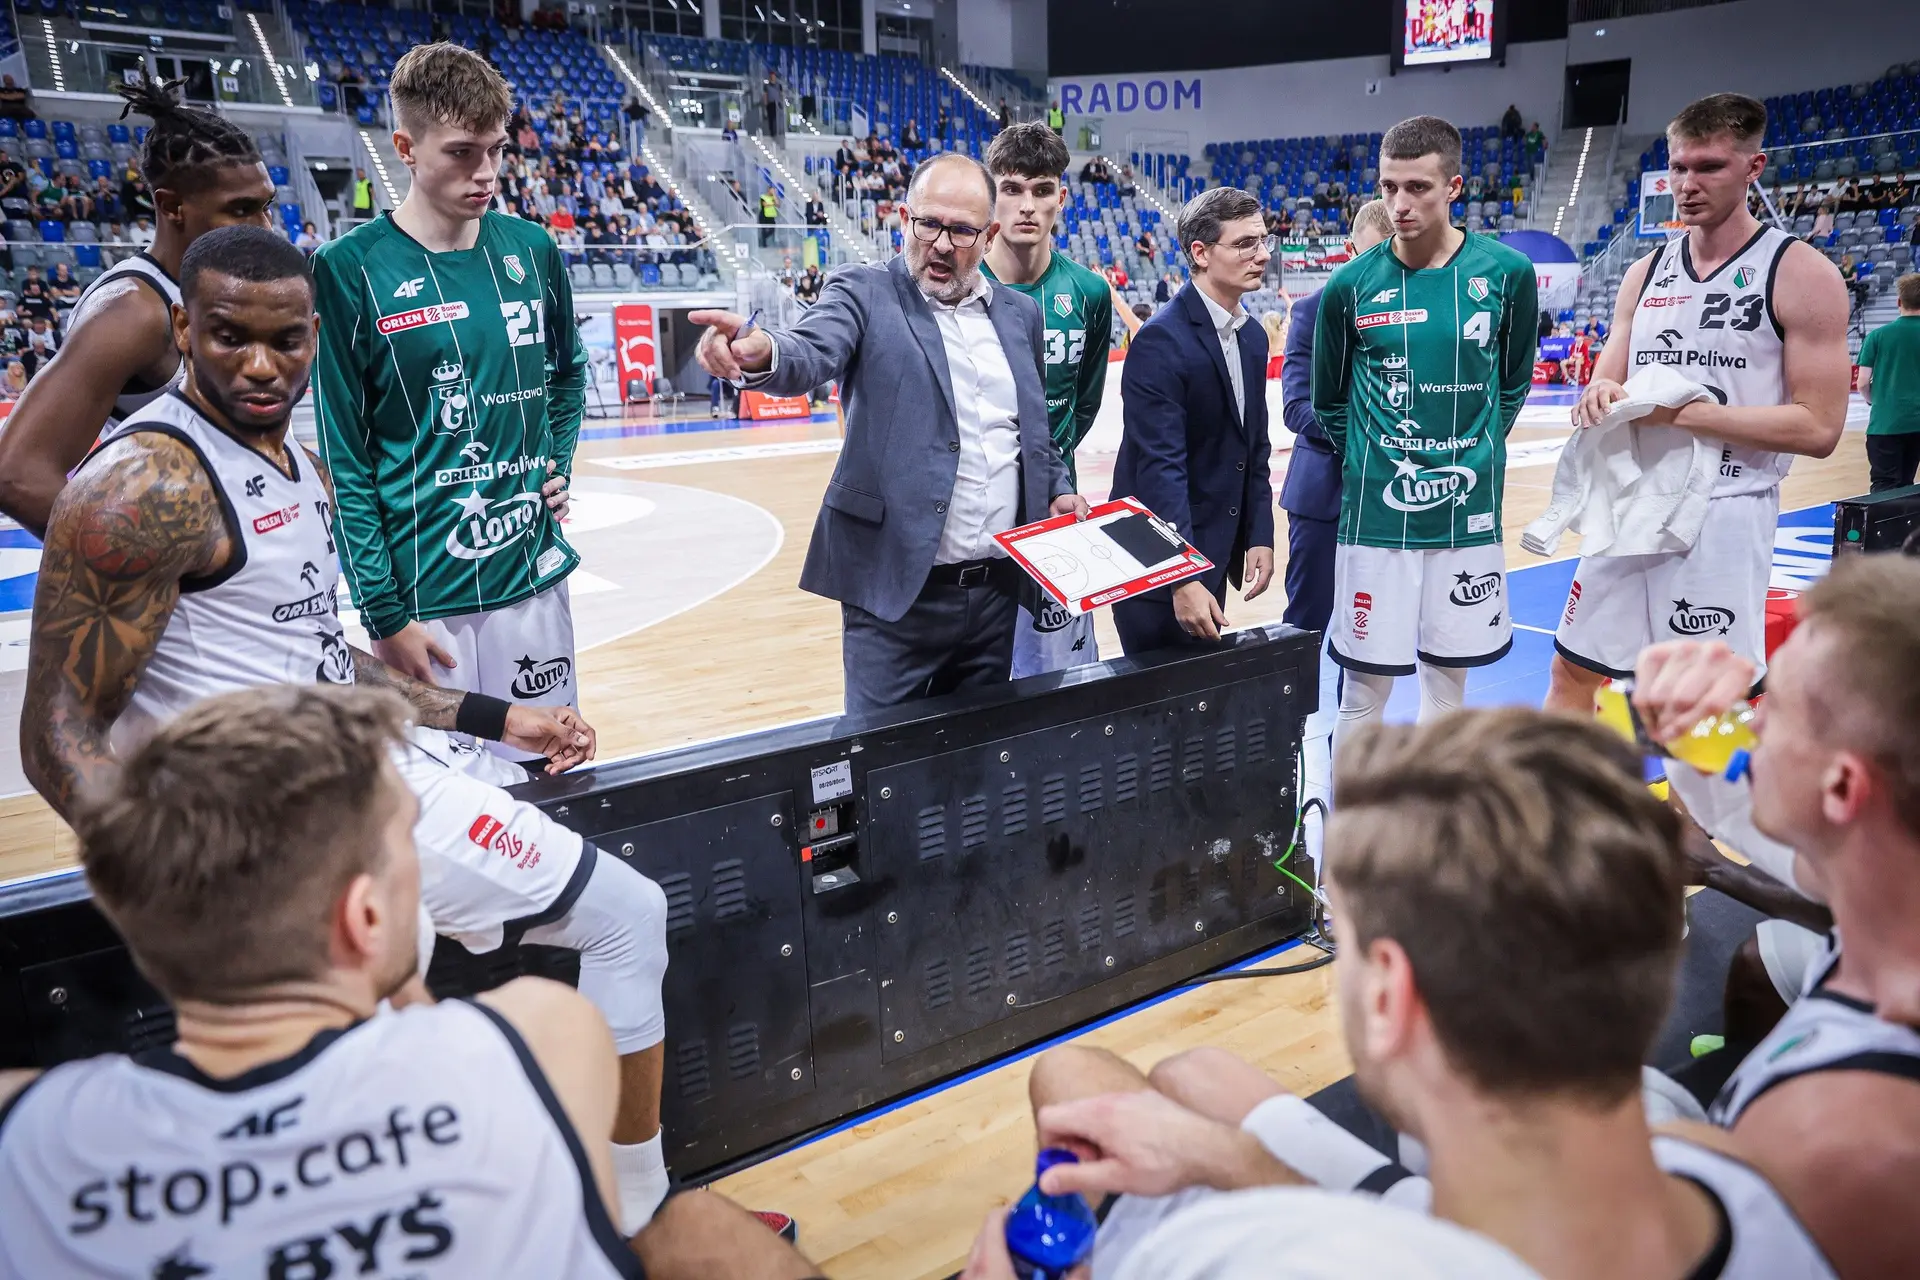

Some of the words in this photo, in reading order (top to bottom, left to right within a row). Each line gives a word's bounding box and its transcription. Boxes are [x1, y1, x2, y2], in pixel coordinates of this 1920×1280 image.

[1061, 79, 1201, 114] RADOM
[393, 277, 426, 298] 4F
[1371, 288, 1400, 303] 4F
[382, 313, 422, 331] ORLEN
[441, 303, 464, 312] Basket
[443, 312, 458, 320] Liga
[500, 299, 545, 347] 21
[1357, 315, 1387, 326] ORLEN
[1699, 293, 1764, 331] 23
[1463, 311, 1491, 348] 4
[1043, 329, 1086, 364] 32
[1637, 351, 1680, 364] ORLEN
[1686, 350, 1746, 369] Paliwa
[481, 386, 543, 406] Warszawa
[1419, 383, 1483, 393] Warszawa
[1425, 436, 1478, 451] Paliwa
[438, 465, 492, 484] ORLEN
[1402, 474, 1460, 503] LOTTO
[256, 513, 282, 530] ORLEN
[470, 503, 533, 547] LOTTO
[1462, 578, 1496, 601] LOTTO
[275, 595, 327, 621] ORLEN
[1680, 613, 1721, 630] LOTTO
[524, 664, 564, 692] LOTTO
[475, 817, 497, 844] ORLEN
[517, 842, 537, 870] Basket
[527, 852, 541, 869] Liga
[69, 1102, 461, 1235] stop.cafe
